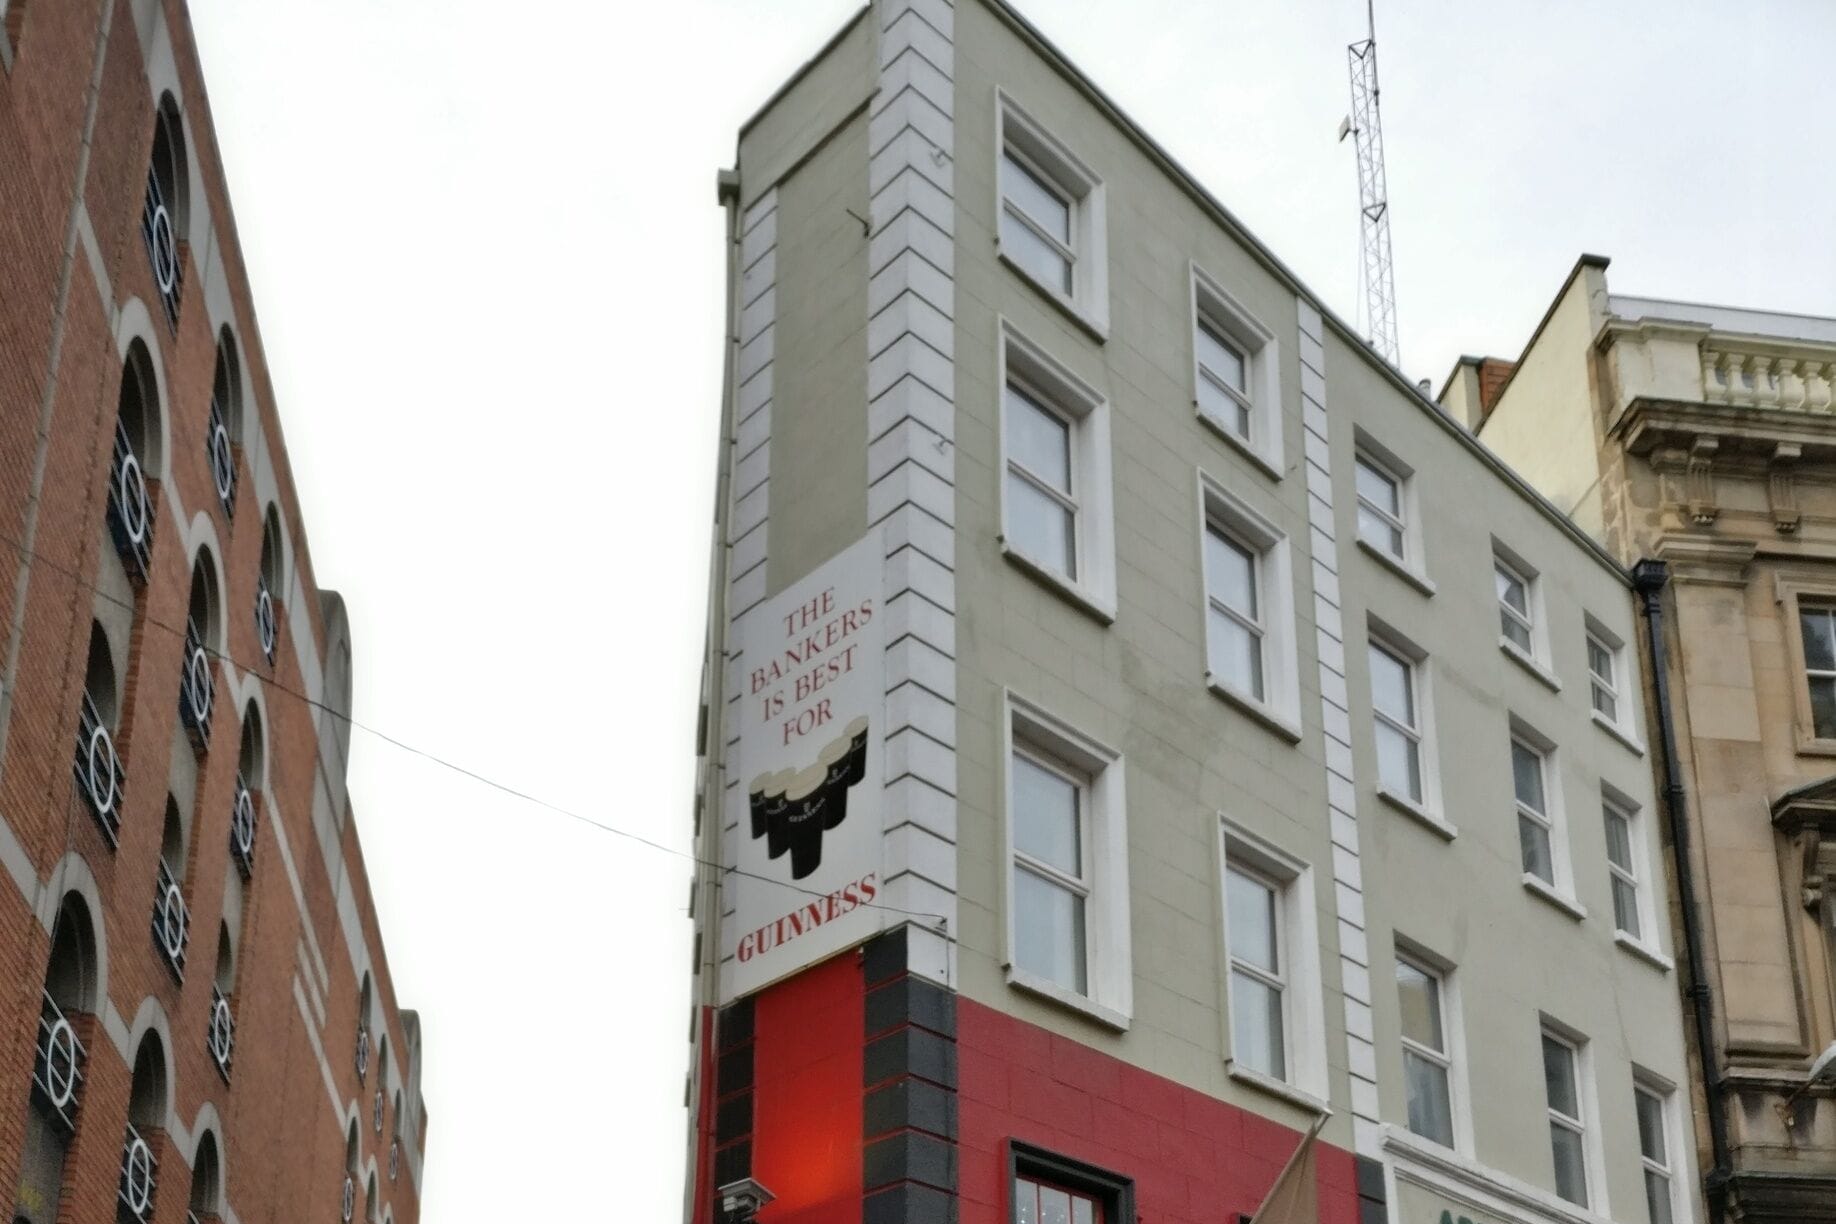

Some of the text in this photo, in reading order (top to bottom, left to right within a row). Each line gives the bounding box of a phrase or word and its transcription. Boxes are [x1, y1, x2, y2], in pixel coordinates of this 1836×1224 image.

[751, 598, 873, 696] BANKERS
[784, 586, 836, 639] THE
[763, 643, 858, 723] IS BEST
[782, 698, 833, 746] FOR
[737, 871, 876, 963] GUINNESS
